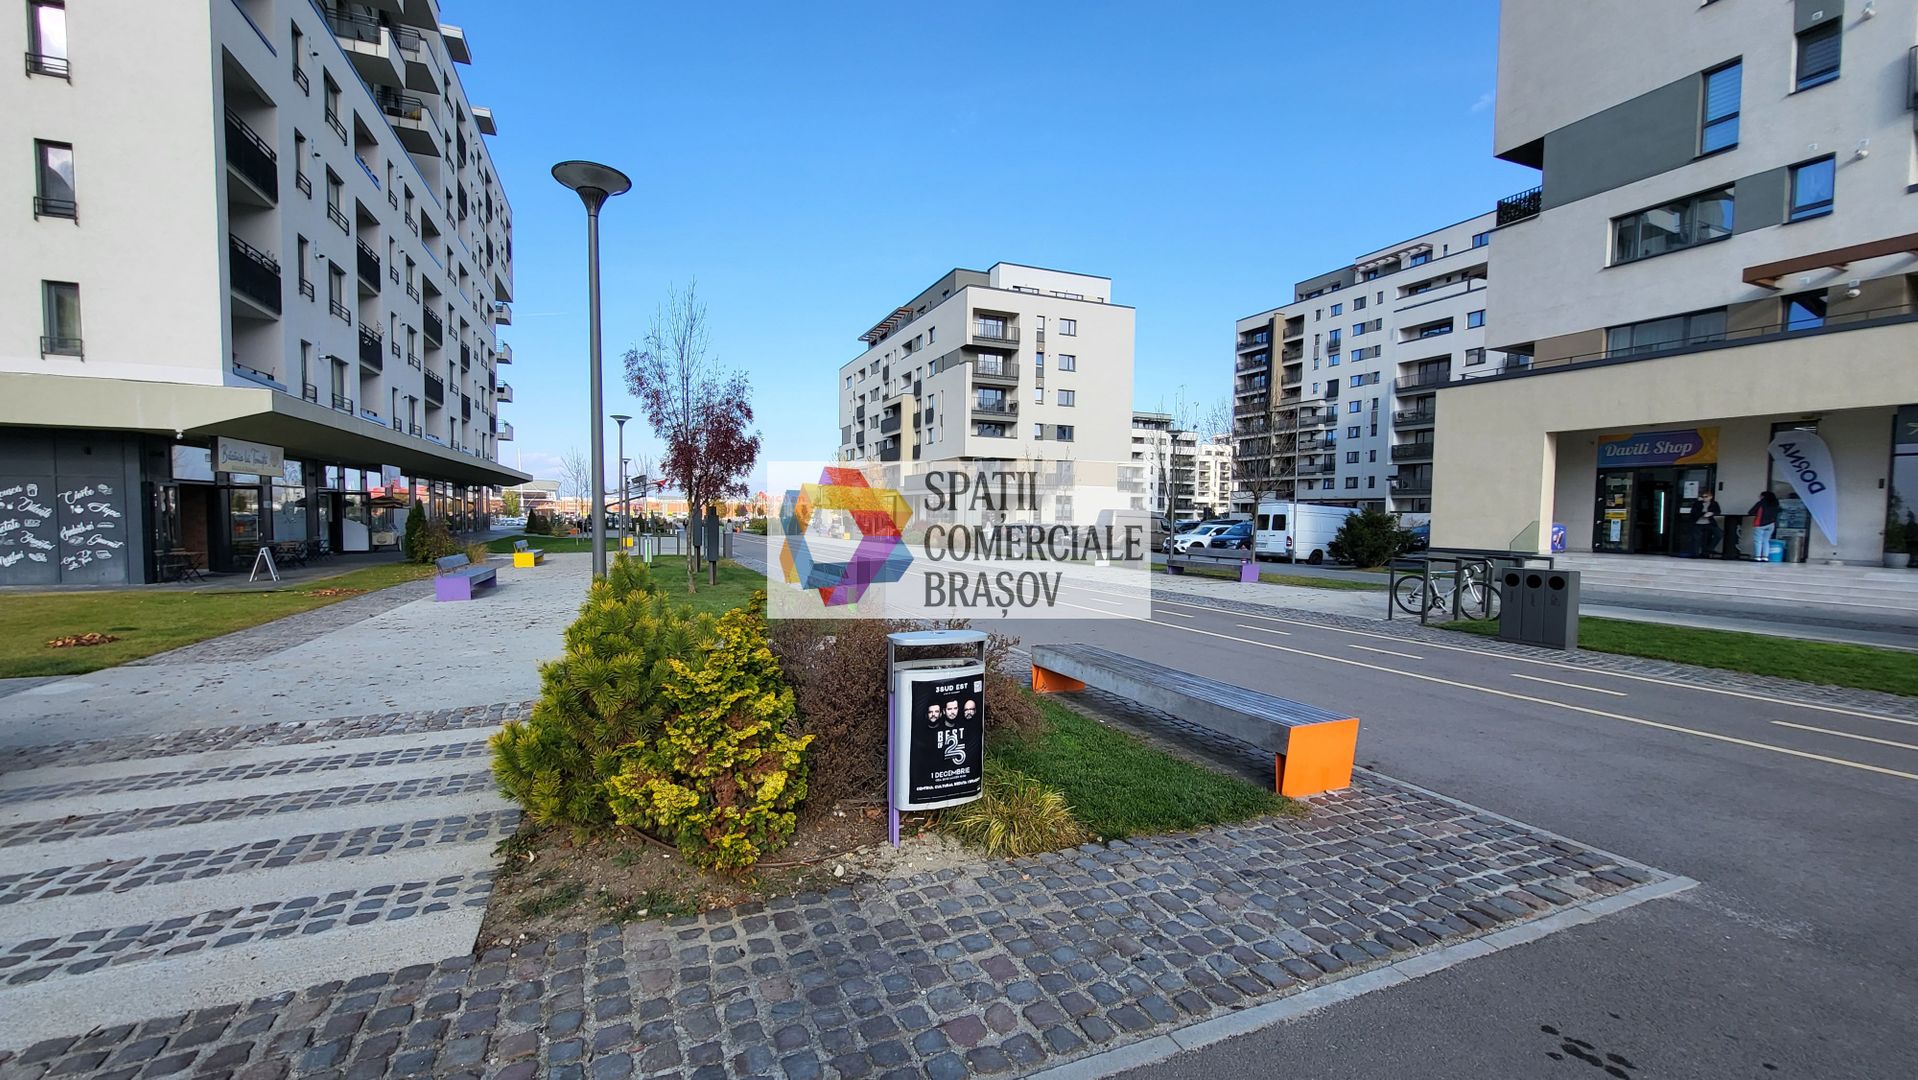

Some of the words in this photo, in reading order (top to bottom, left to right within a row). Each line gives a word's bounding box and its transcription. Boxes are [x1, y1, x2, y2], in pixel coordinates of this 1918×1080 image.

[1604, 442, 1651, 457] Davili
[1653, 440, 1693, 456] Shop
[937, 727, 965, 746] BEST
[944, 736, 967, 765] 25
[934, 766, 971, 779] DECEMBRIE
